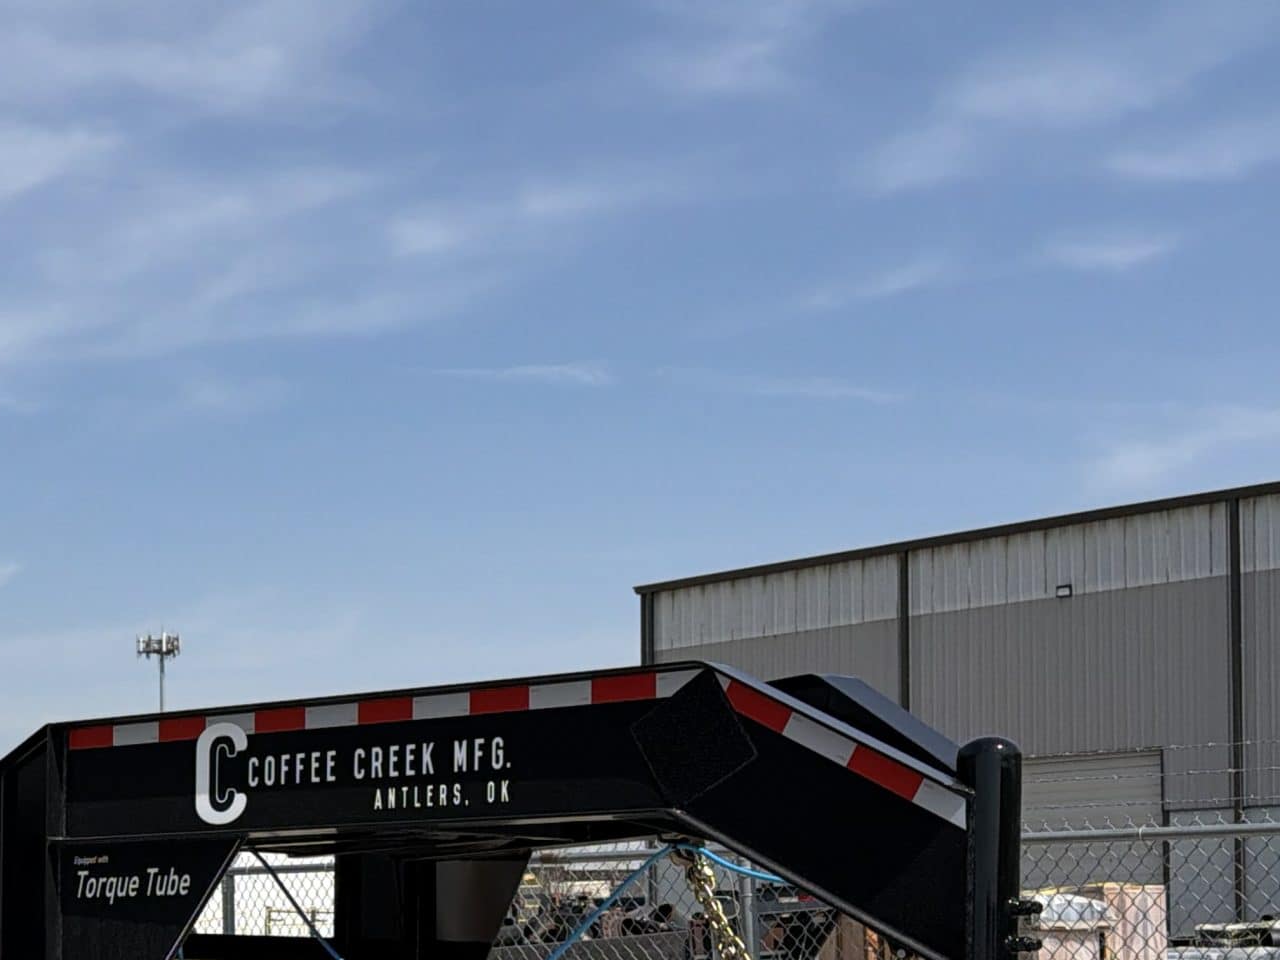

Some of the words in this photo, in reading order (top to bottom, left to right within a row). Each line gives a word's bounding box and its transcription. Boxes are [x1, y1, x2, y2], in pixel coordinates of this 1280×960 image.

[248, 750, 337, 787] COFFEE
[353, 742, 435, 780] CREEK
[453, 736, 512, 773] MFG.
[487, 779, 510, 803] OK
[77, 870, 140, 905] Torque
[146, 867, 191, 897] Tube
